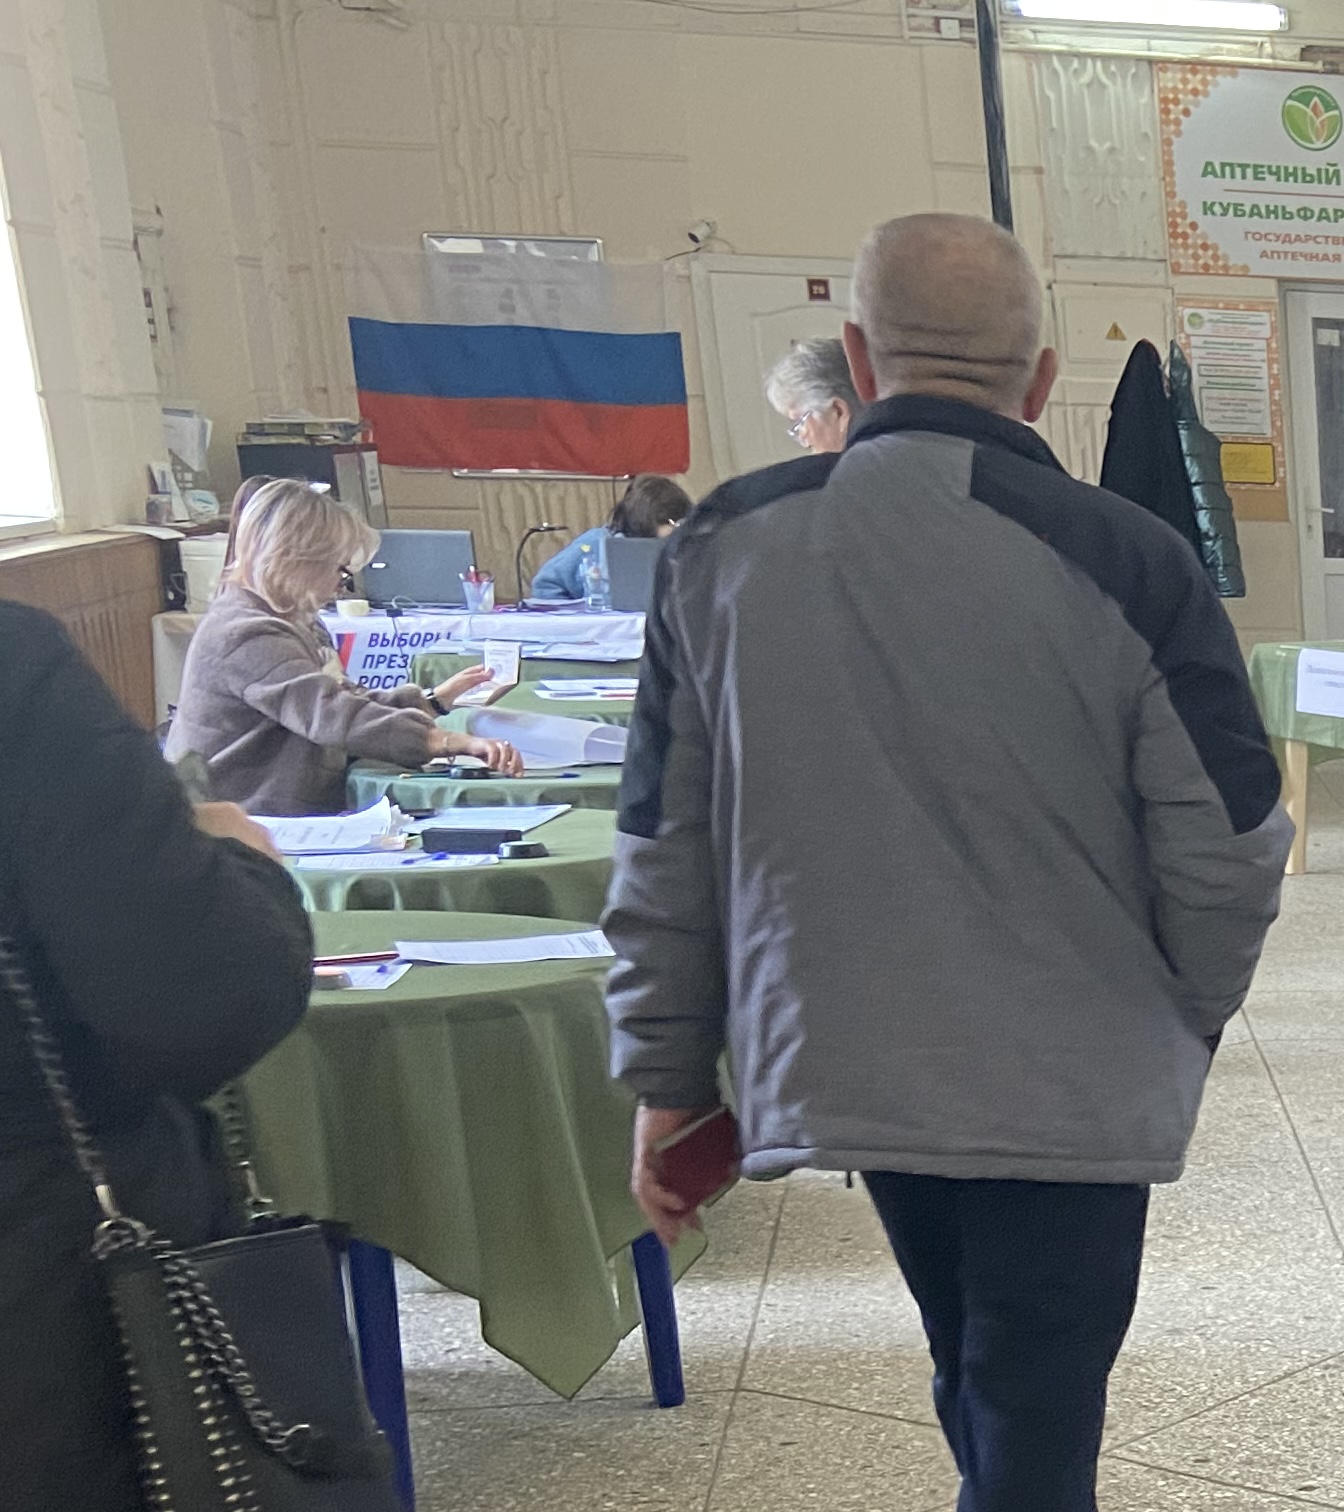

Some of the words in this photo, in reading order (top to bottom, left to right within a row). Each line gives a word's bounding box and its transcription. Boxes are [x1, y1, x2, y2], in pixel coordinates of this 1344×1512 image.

[1201, 161, 1341, 186] АПТЕЧНЫЙ
[1259, 250, 1342, 263] АПТЕЧНАЯ
[362, 654, 415, 670] ПРЕЗ
